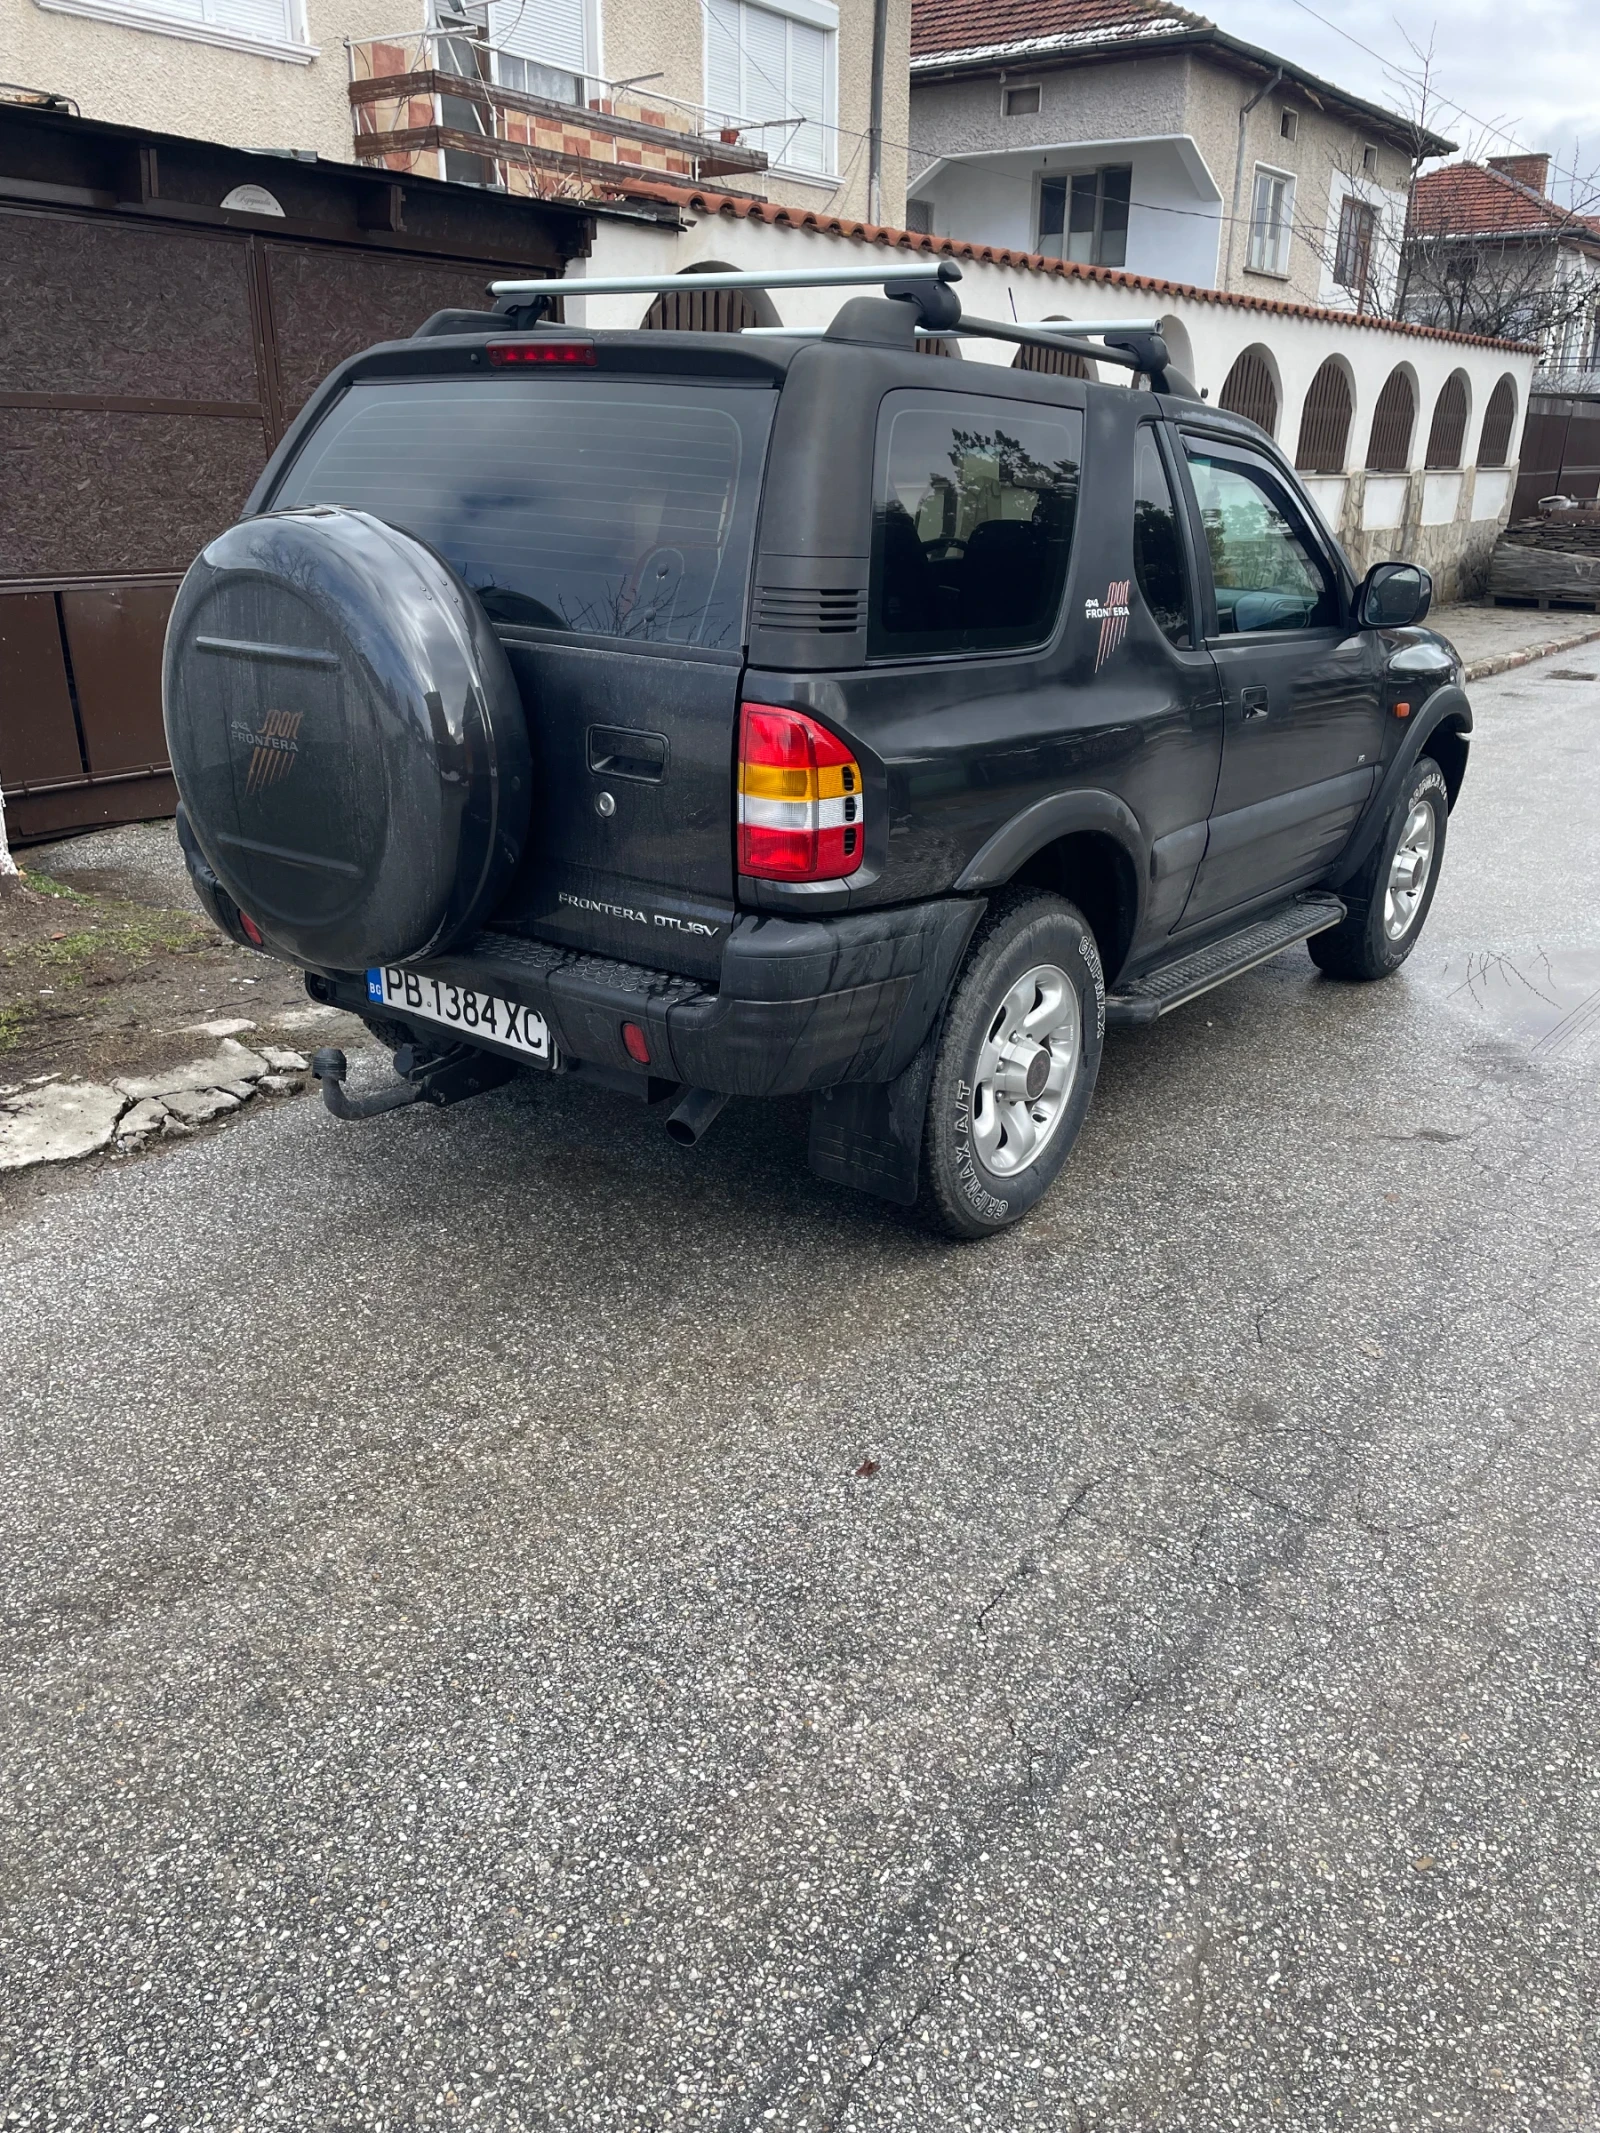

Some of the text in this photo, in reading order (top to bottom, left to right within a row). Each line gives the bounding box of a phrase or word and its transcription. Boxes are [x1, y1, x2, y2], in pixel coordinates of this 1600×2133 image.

[1085, 607, 1130, 619] FRONTERA
[231, 731, 299, 752] FRONTERA
[558, 892, 648, 924] FRONTERA
[369, 982, 382, 995] BG
[1079, 936, 1105, 1039] GRIPMAX
[954, 1080, 1009, 1219] GRIPMAX A/T
